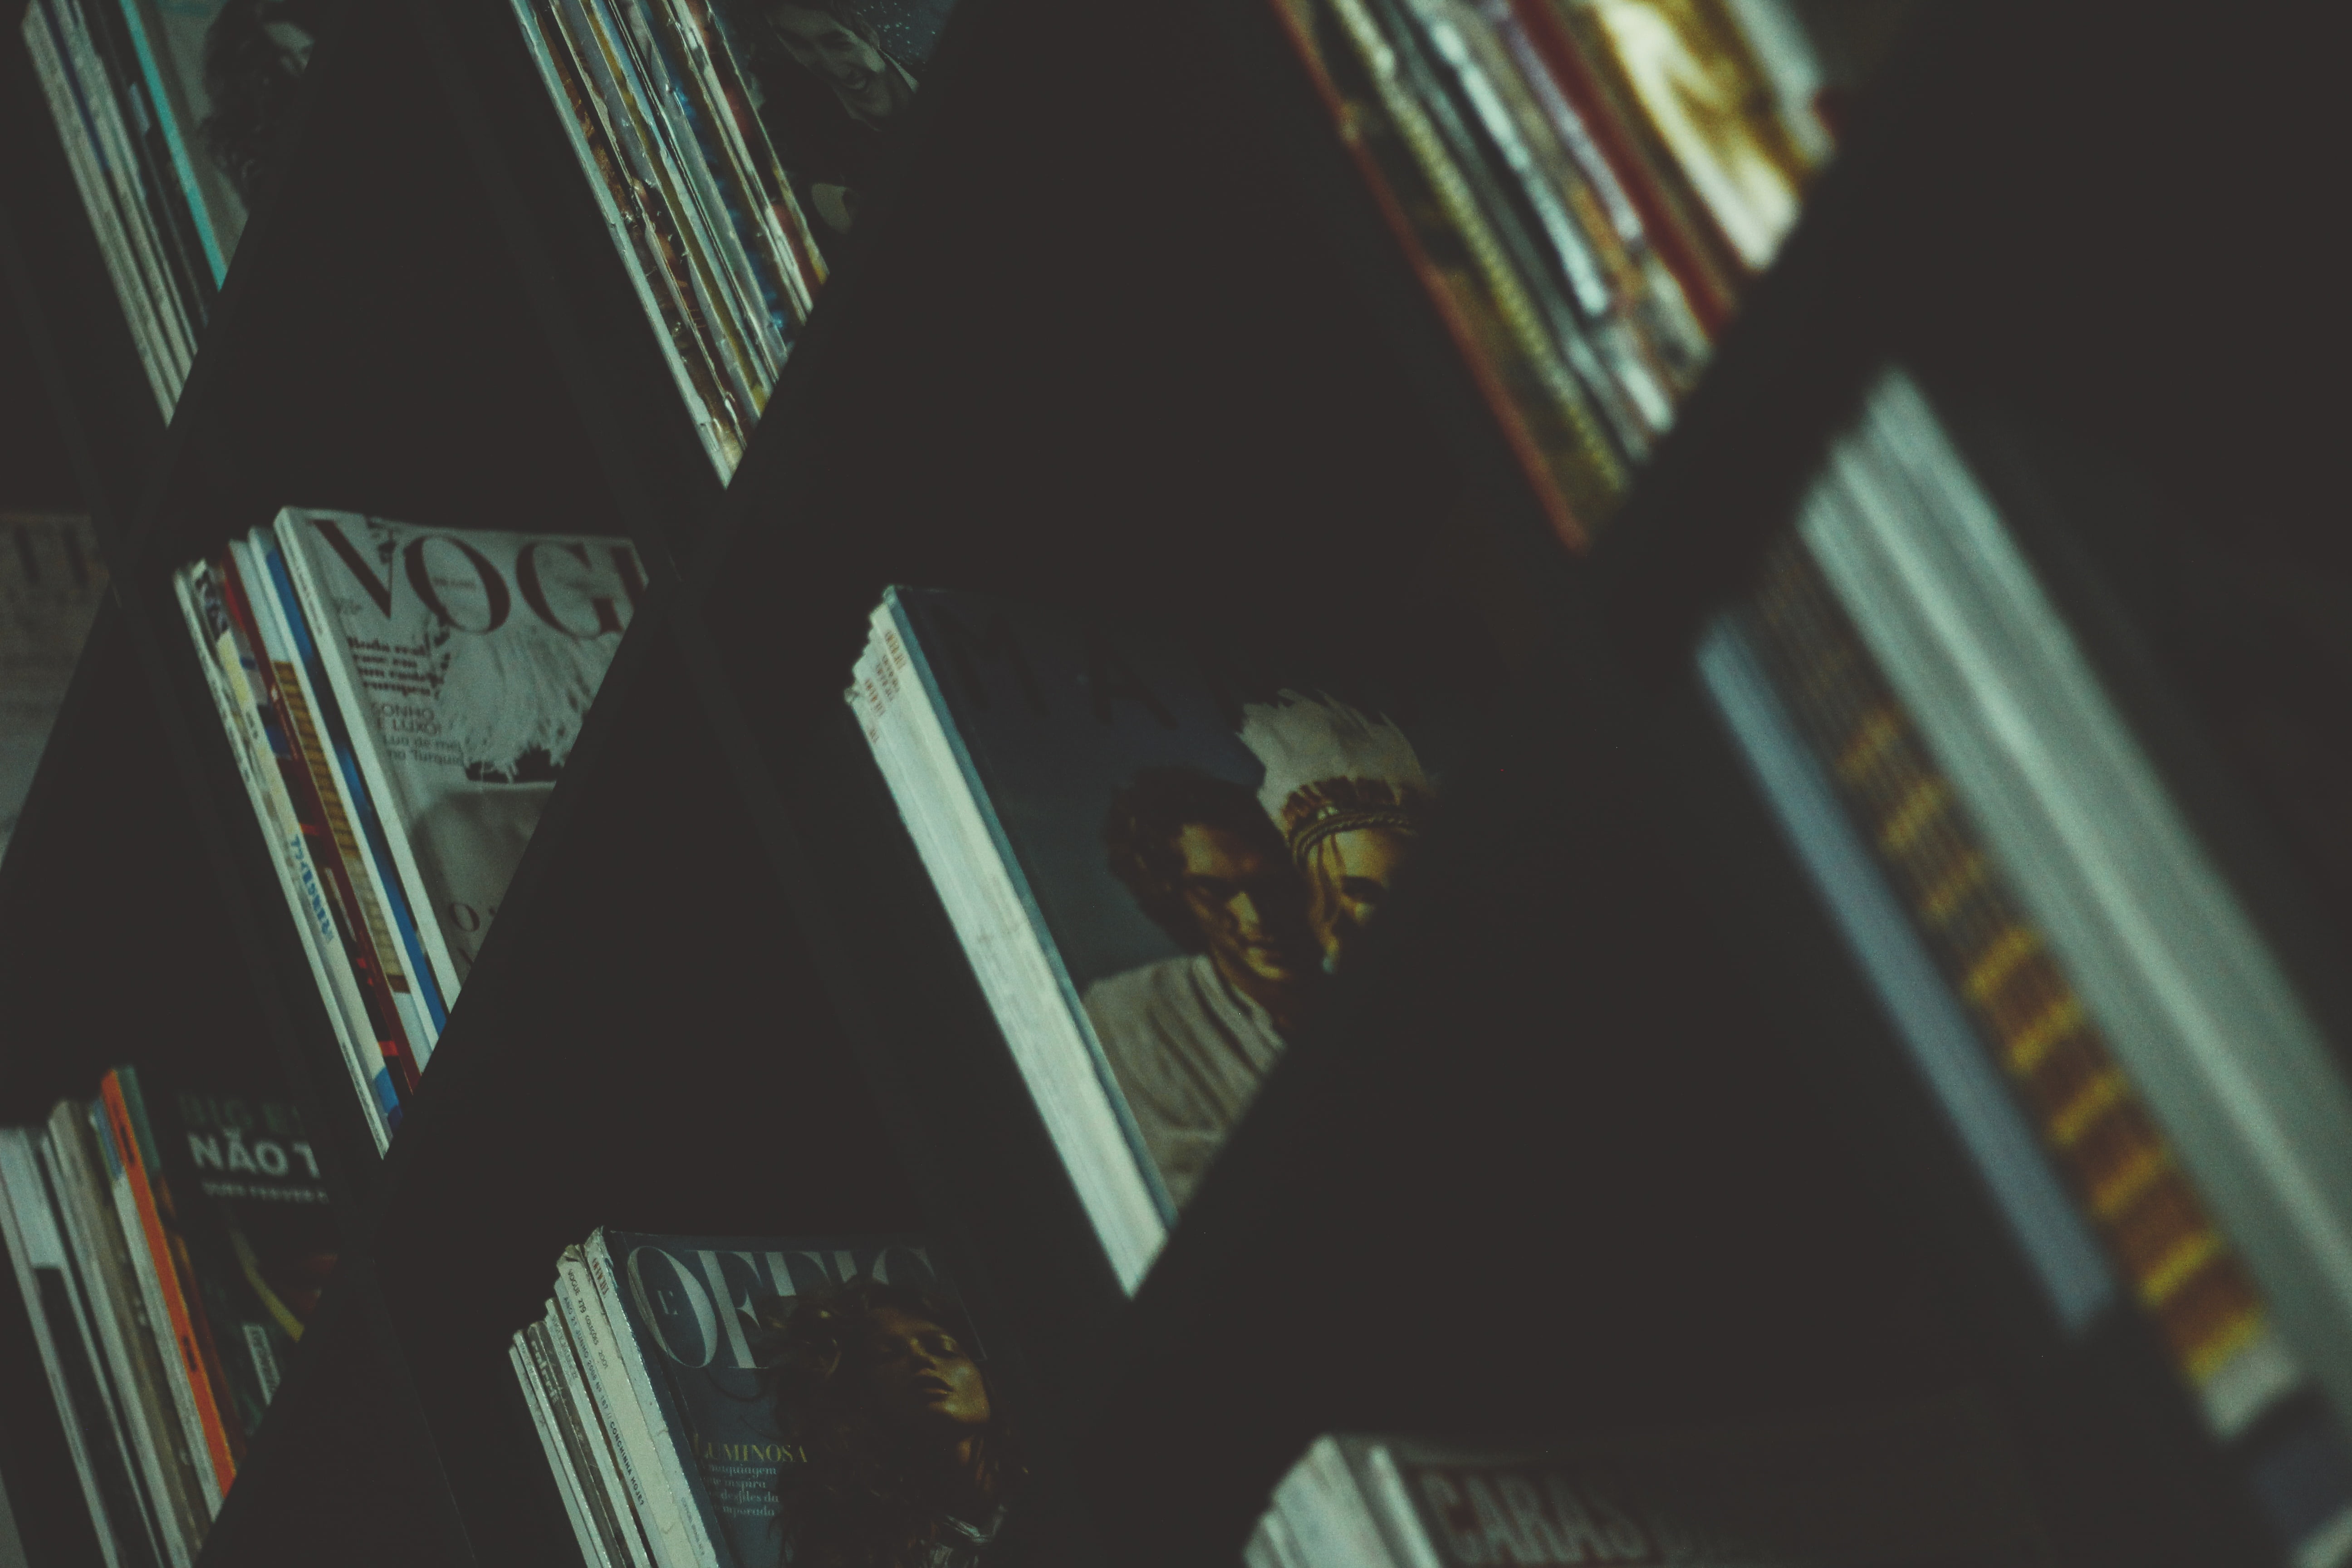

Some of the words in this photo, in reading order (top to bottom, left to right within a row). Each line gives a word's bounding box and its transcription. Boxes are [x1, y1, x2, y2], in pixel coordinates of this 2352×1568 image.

[186, 1126, 290, 1178] NÃO
[568, 1269, 580, 1295] VOGUE
[578, 1298, 587, 1313] 279
[609, 1421, 633, 1475] CONCHINHA
[630, 1476, 645, 1505] HOJE?
[721, 1504, 775, 1518] mporada
[1418, 1469, 1651, 1565] CARAS
